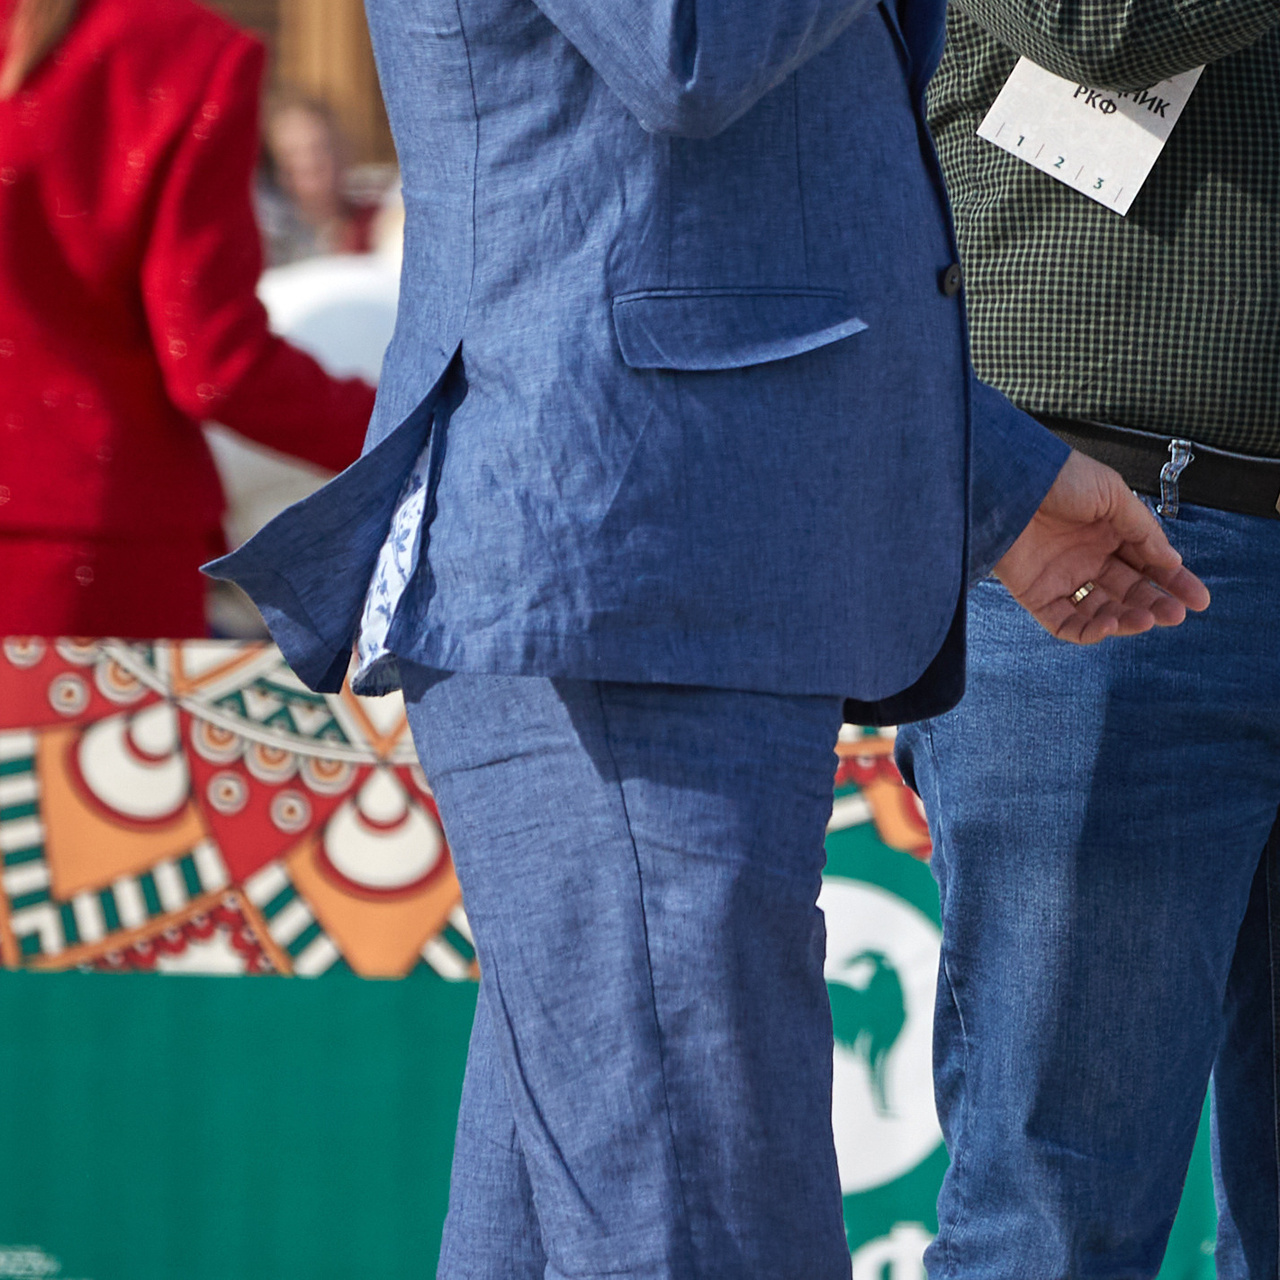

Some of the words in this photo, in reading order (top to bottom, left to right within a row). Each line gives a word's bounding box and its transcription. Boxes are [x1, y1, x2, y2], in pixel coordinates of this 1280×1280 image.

[1073, 85, 1117, 115] РКФ
[1017, 136, 1025, 147] 1
[1054, 156, 1065, 169] 2
[1093, 178, 1105, 190] 3
